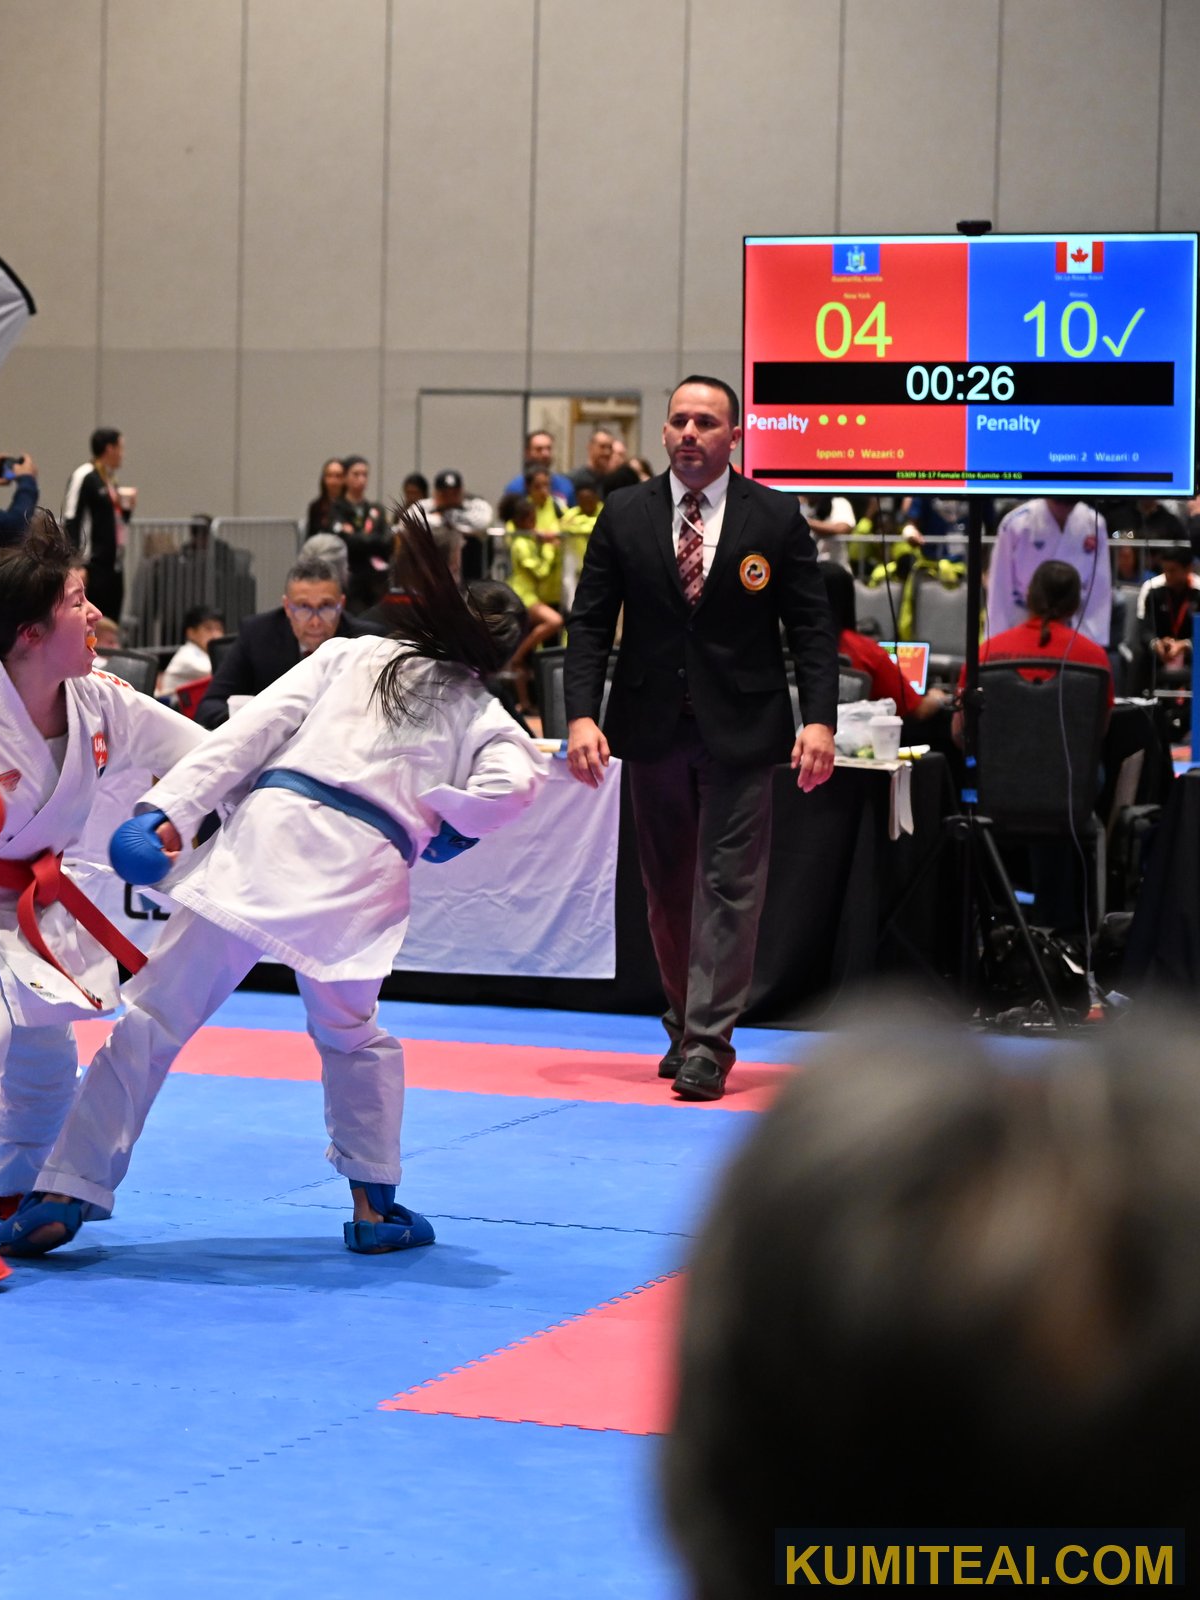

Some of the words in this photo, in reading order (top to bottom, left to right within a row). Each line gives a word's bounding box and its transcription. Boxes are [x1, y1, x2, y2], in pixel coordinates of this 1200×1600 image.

[815, 301, 893, 359] 04
[1023, 300, 1098, 358] 10
[906, 364, 1016, 402] 00:26
[747, 413, 810, 434] Penalty
[976, 414, 1041, 435] Penalty
[816, 448, 845, 461] Ippon:
[847, 448, 855, 459] 0
[861, 448, 895, 460] Wazari:
[897, 448, 905, 460] 0
[1049, 451, 1079, 463] Ippon:
[1081, 451, 1088, 462] 2
[1095, 451, 1129, 462] Wazari:
[1132, 451, 1140, 462] 0
[937, 471, 960, 479] Female
[961, 471, 976, 479] Elite
[977, 471, 1000, 480] Kumite
[94, 737, 107, 753] USA
